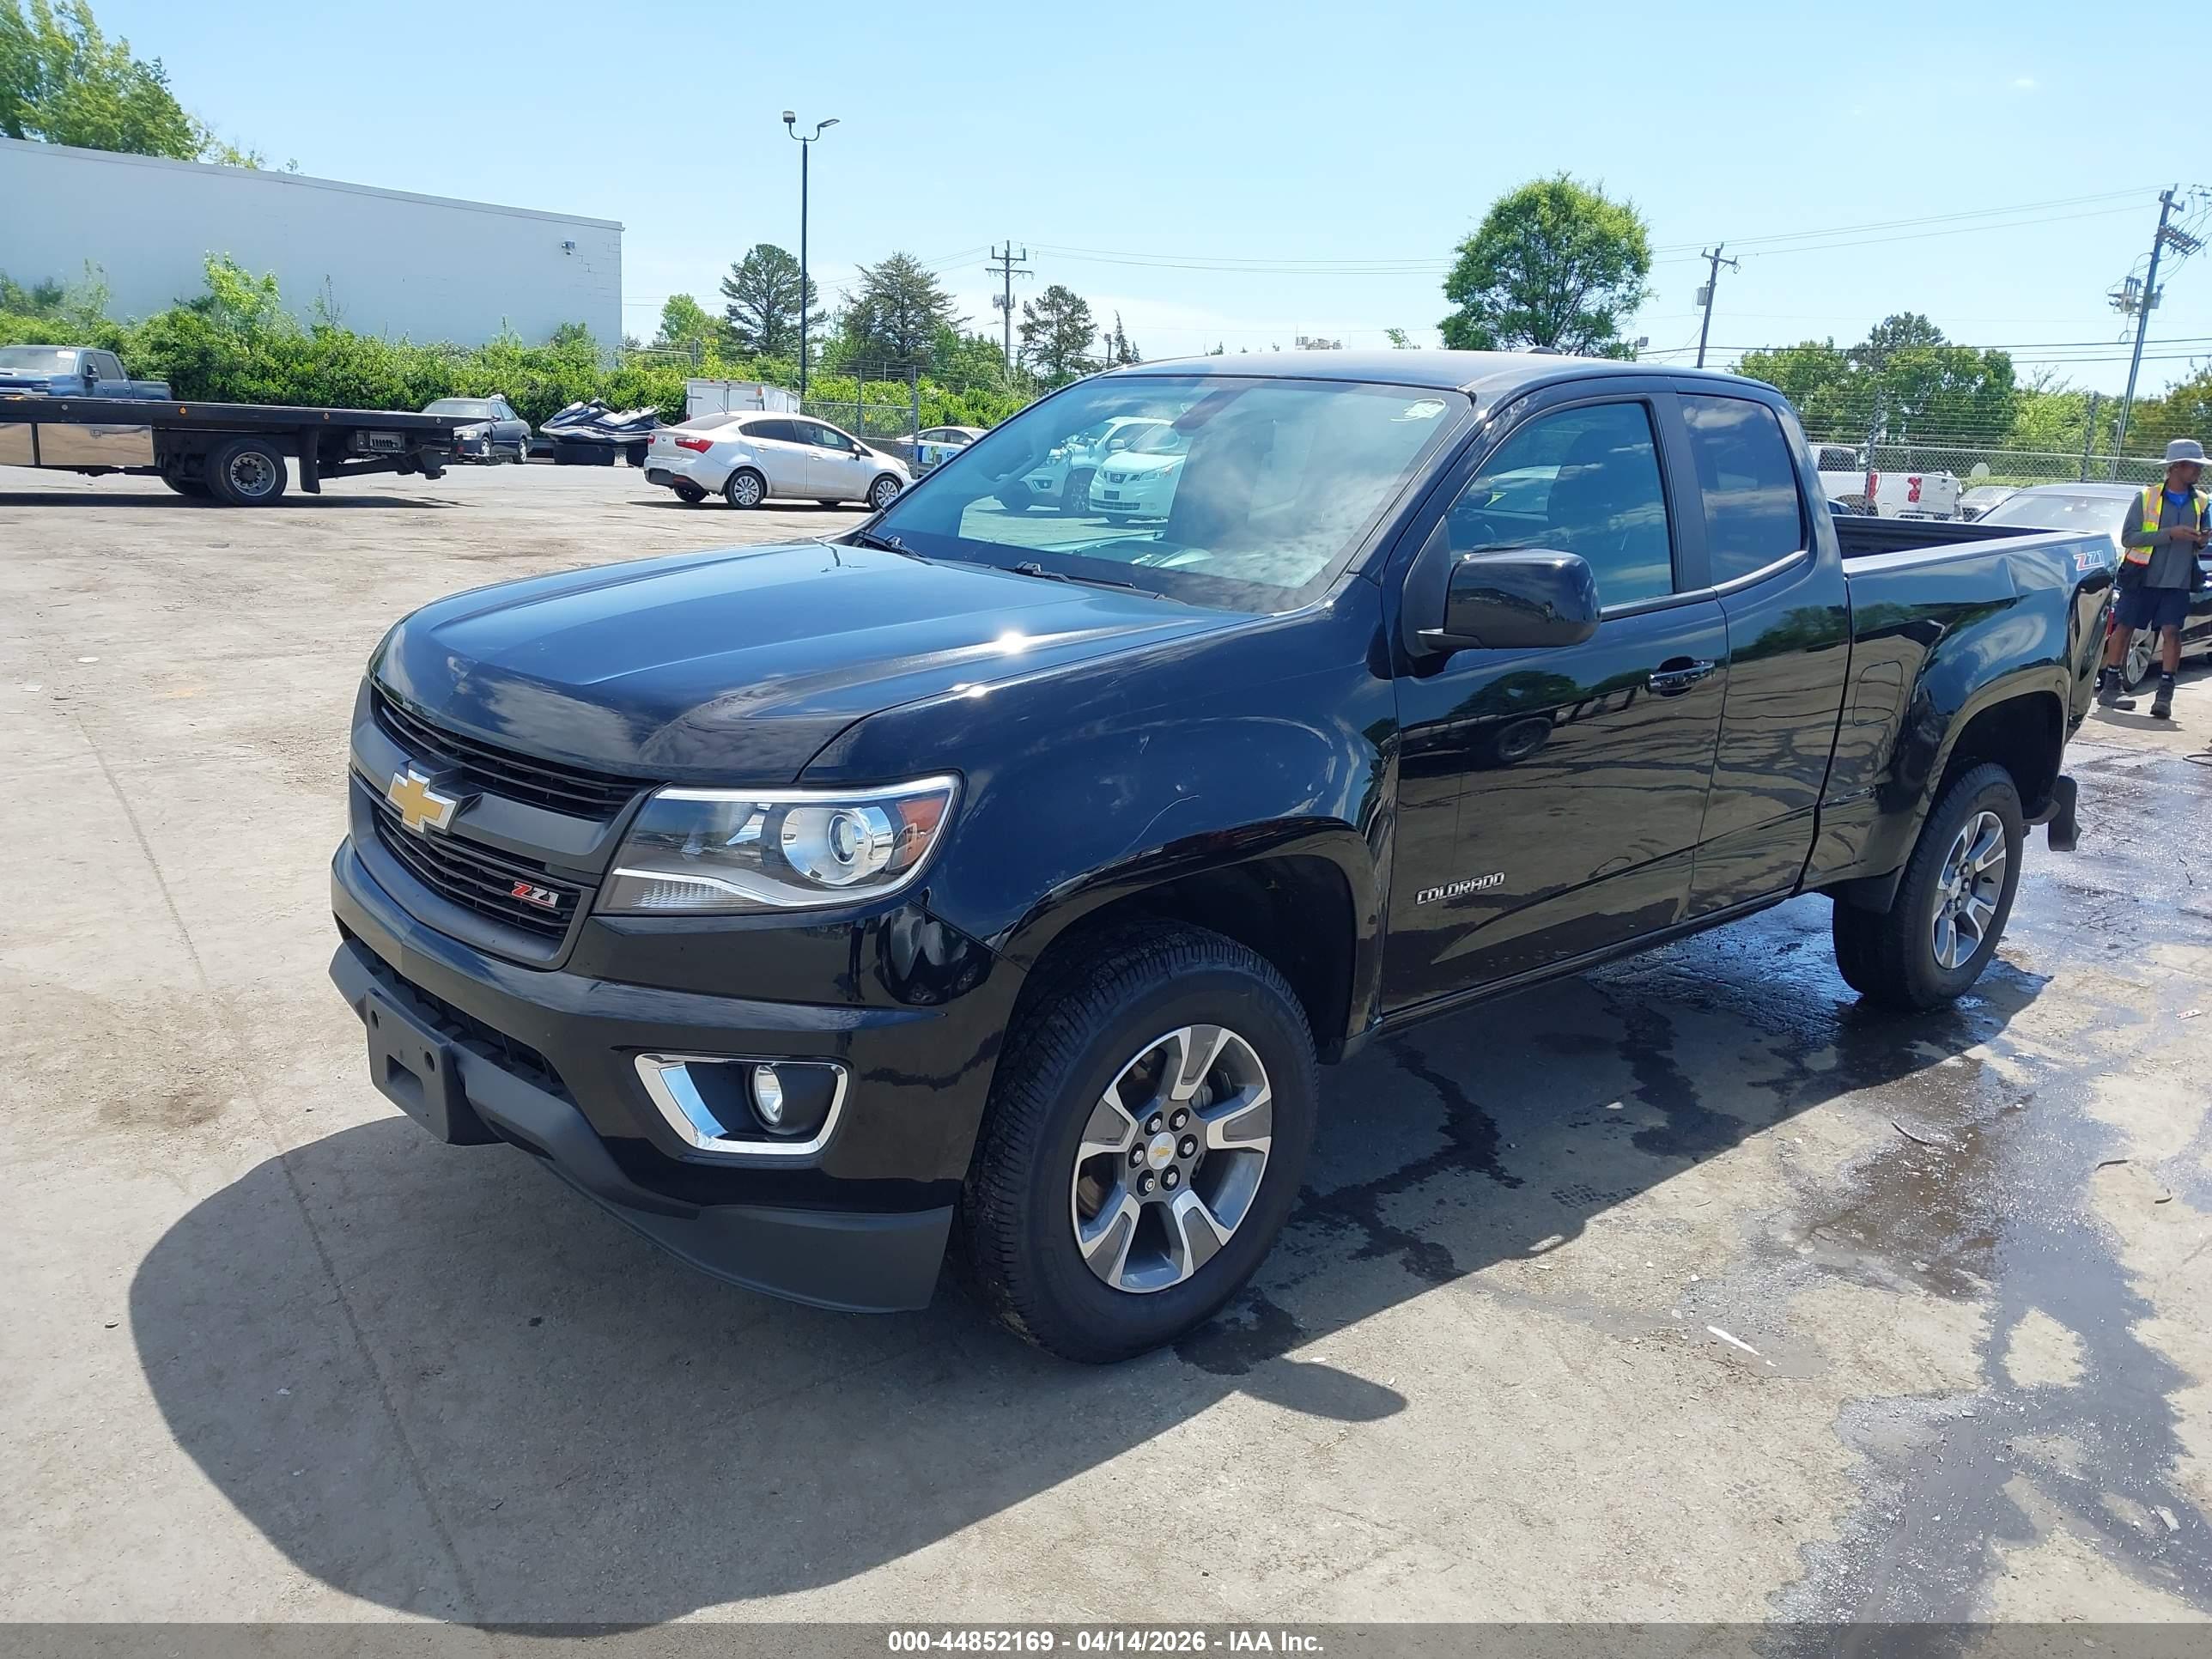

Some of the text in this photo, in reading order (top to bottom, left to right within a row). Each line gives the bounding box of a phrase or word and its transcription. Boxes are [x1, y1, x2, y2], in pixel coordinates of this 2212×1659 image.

[2073, 550, 2105, 571] Z71
[512, 881, 559, 908] Z71
[1416, 872, 1505, 905] COLORADO
